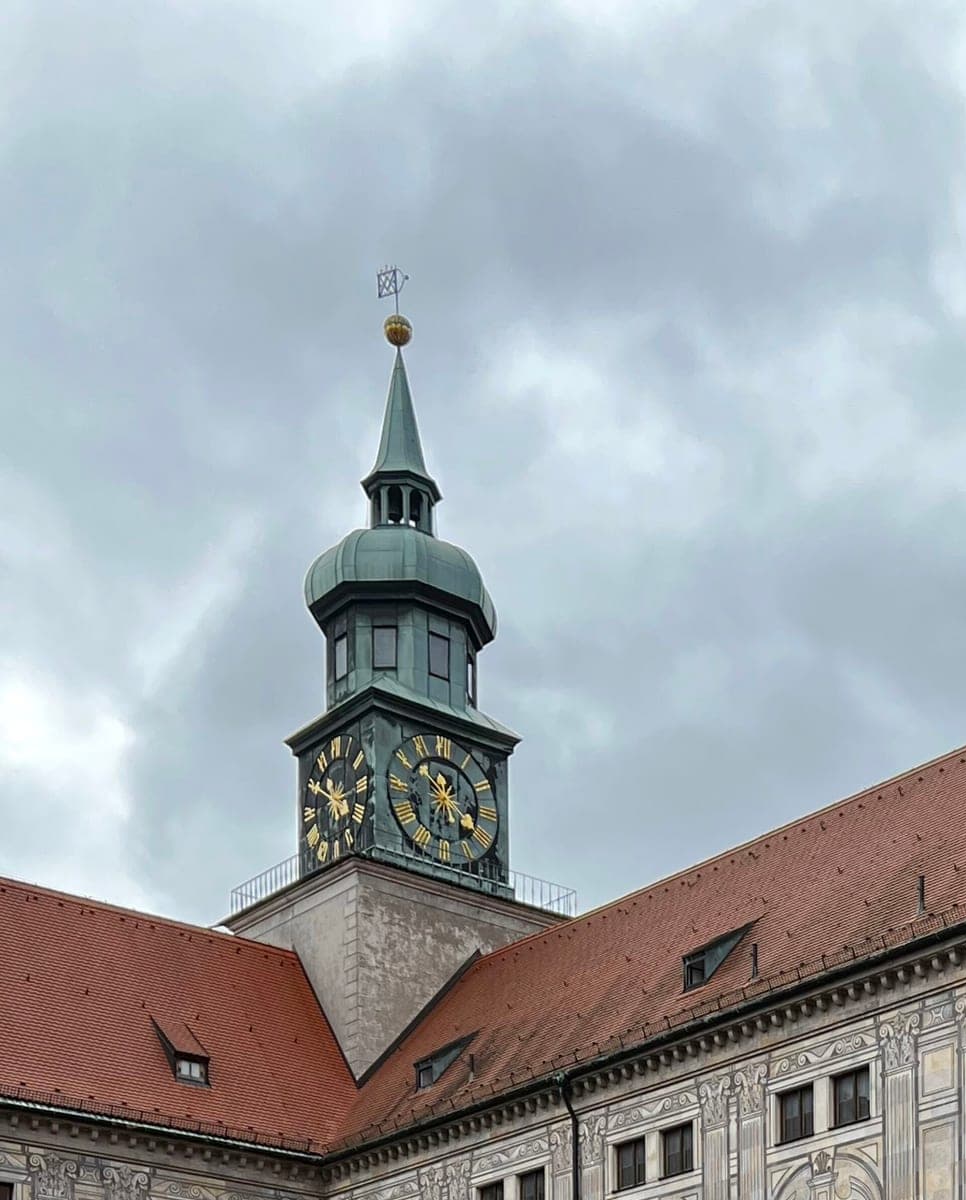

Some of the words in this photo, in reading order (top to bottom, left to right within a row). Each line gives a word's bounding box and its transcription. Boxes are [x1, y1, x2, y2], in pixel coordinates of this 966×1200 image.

[412, 735, 430, 758] XI
[435, 735, 452, 760] XII
[395, 748, 413, 769] X
[460, 754, 471, 769] I
[389, 773, 409, 793] IX
[473, 779, 491, 792] II
[393, 800, 416, 825] VIII
[479, 805, 497, 822] III
[412, 824, 431, 849] VII
[472, 824, 493, 849] IIII
[438, 838, 450, 862] VI
[462, 840, 475, 859] V
